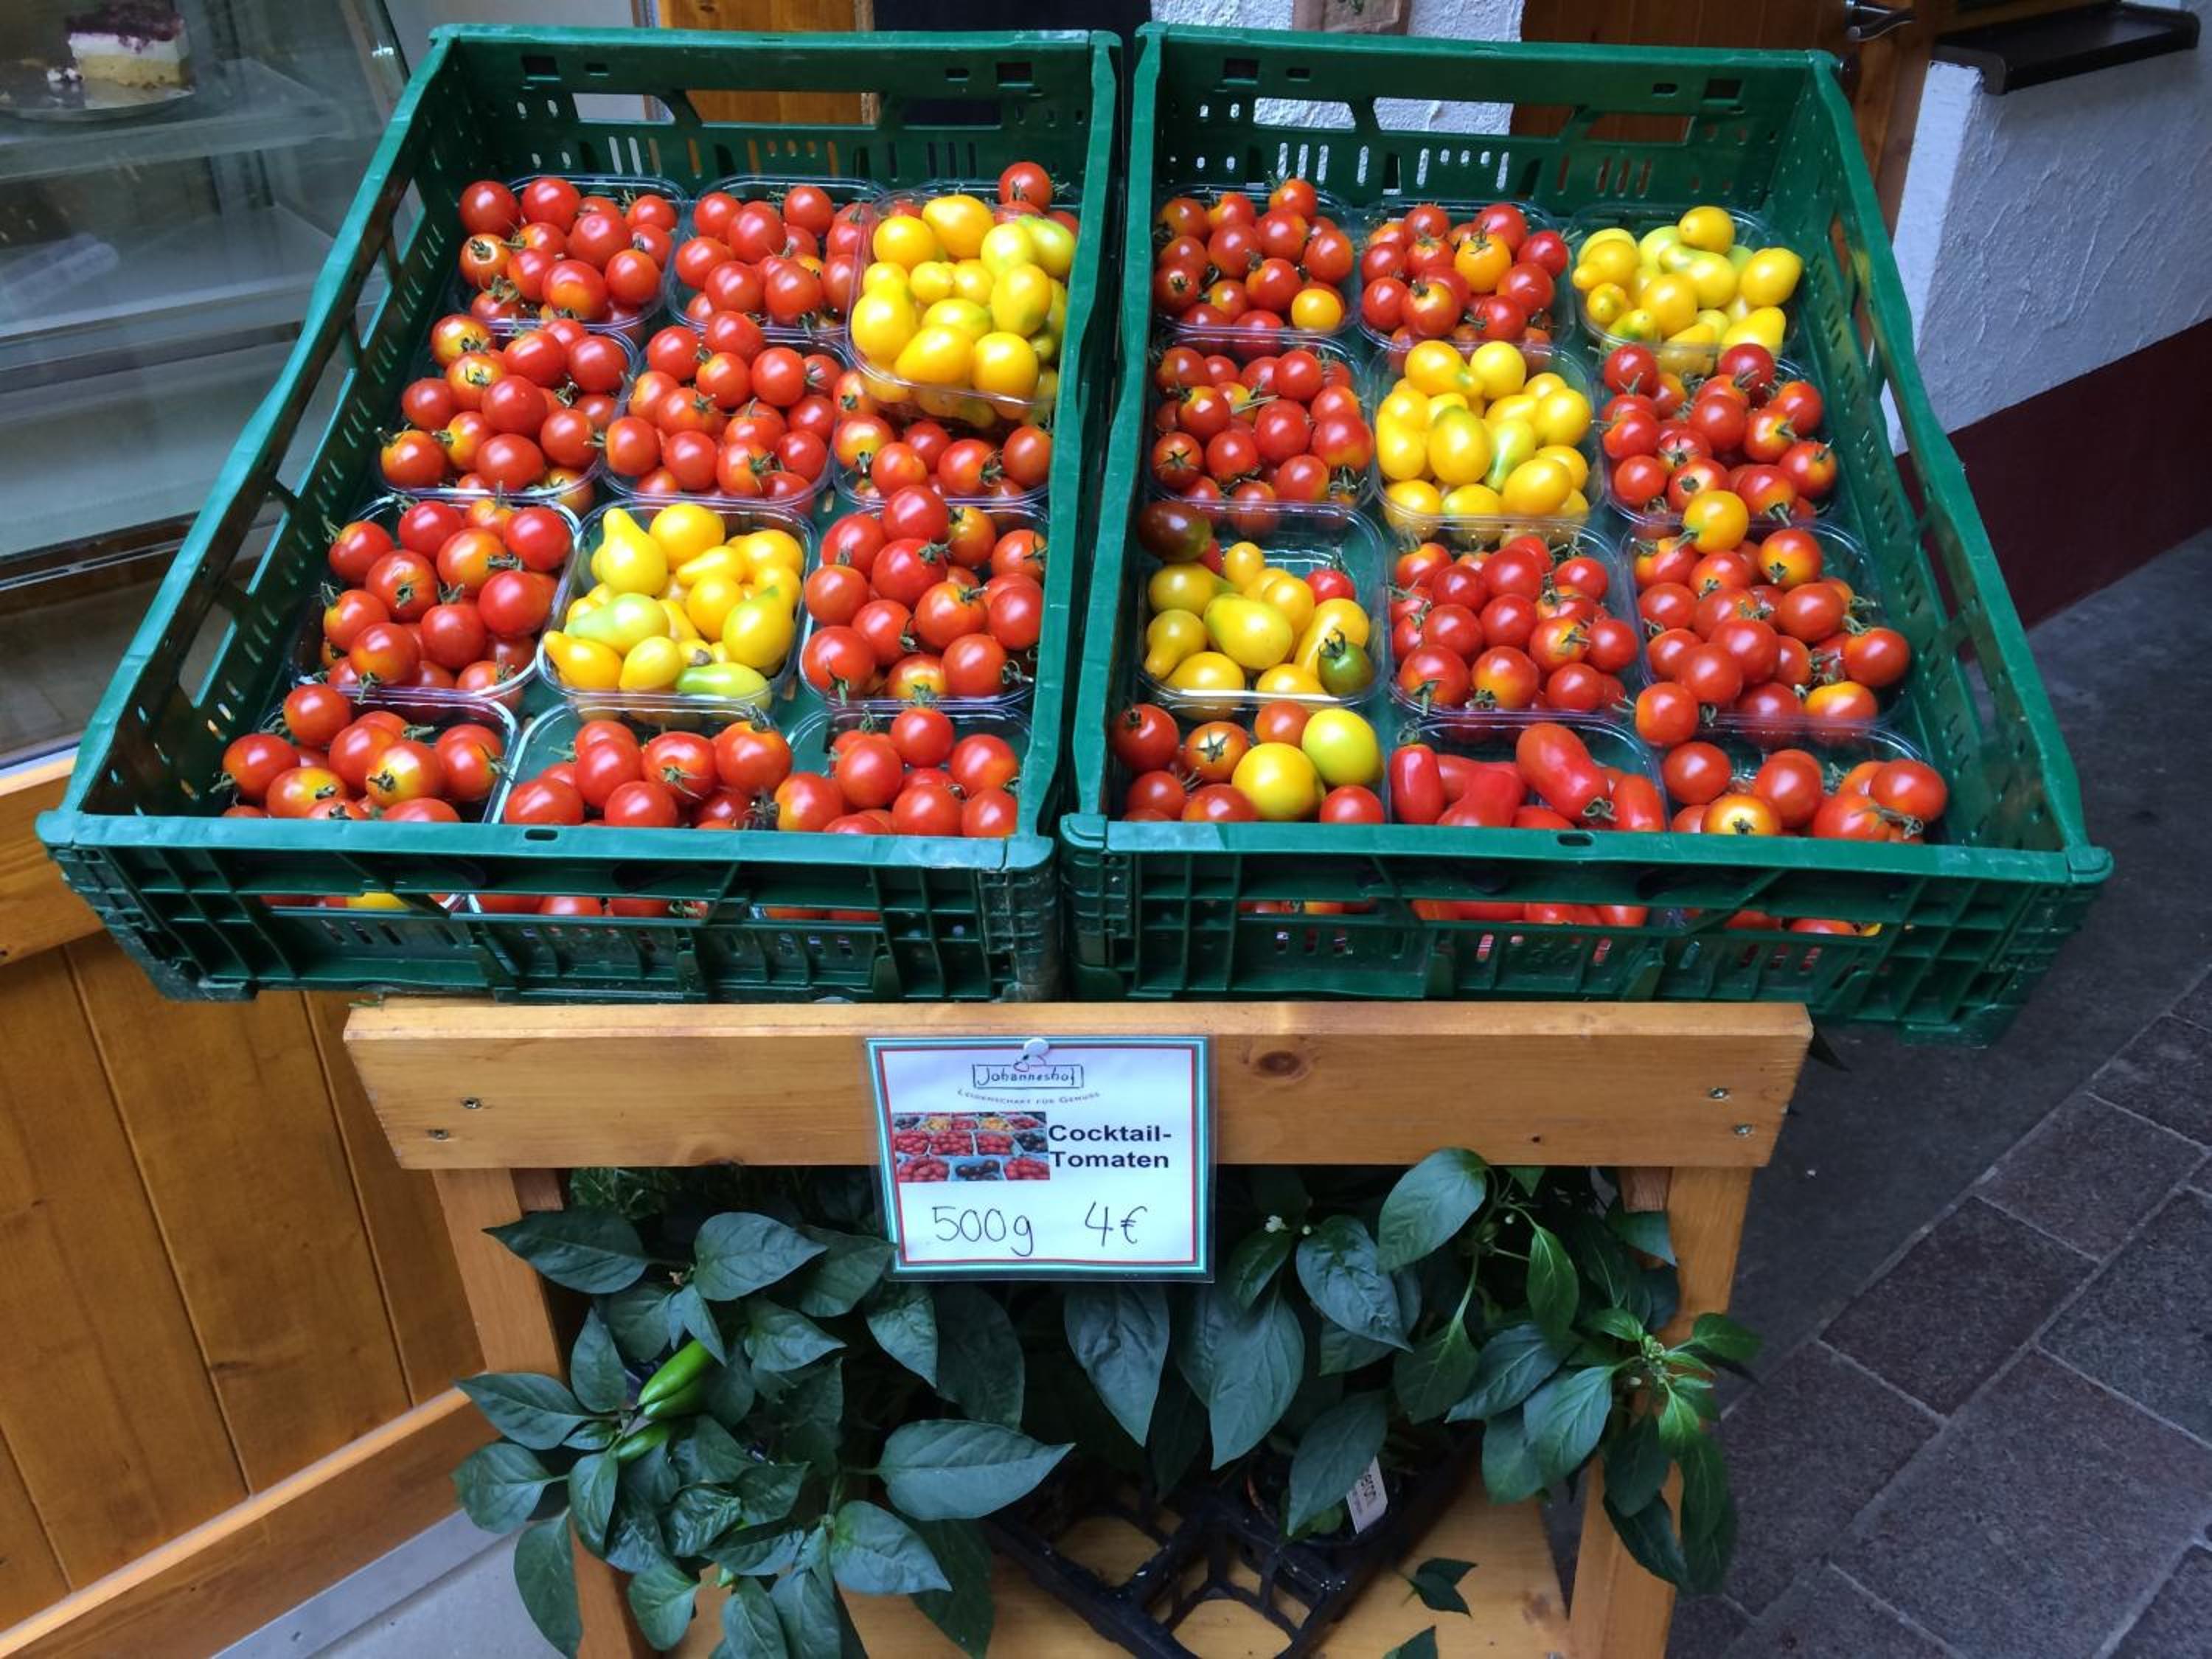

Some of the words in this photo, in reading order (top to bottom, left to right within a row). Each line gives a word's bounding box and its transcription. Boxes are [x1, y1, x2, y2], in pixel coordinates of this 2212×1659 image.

[976, 1067, 1076, 1086] Johanneshof
[1048, 1124, 1172, 1142] Cocktail-
[1049, 1150, 1169, 1169] Tomaten
[931, 1205, 1034, 1258] 500g
[1084, 1200, 1148, 1248] 4€
